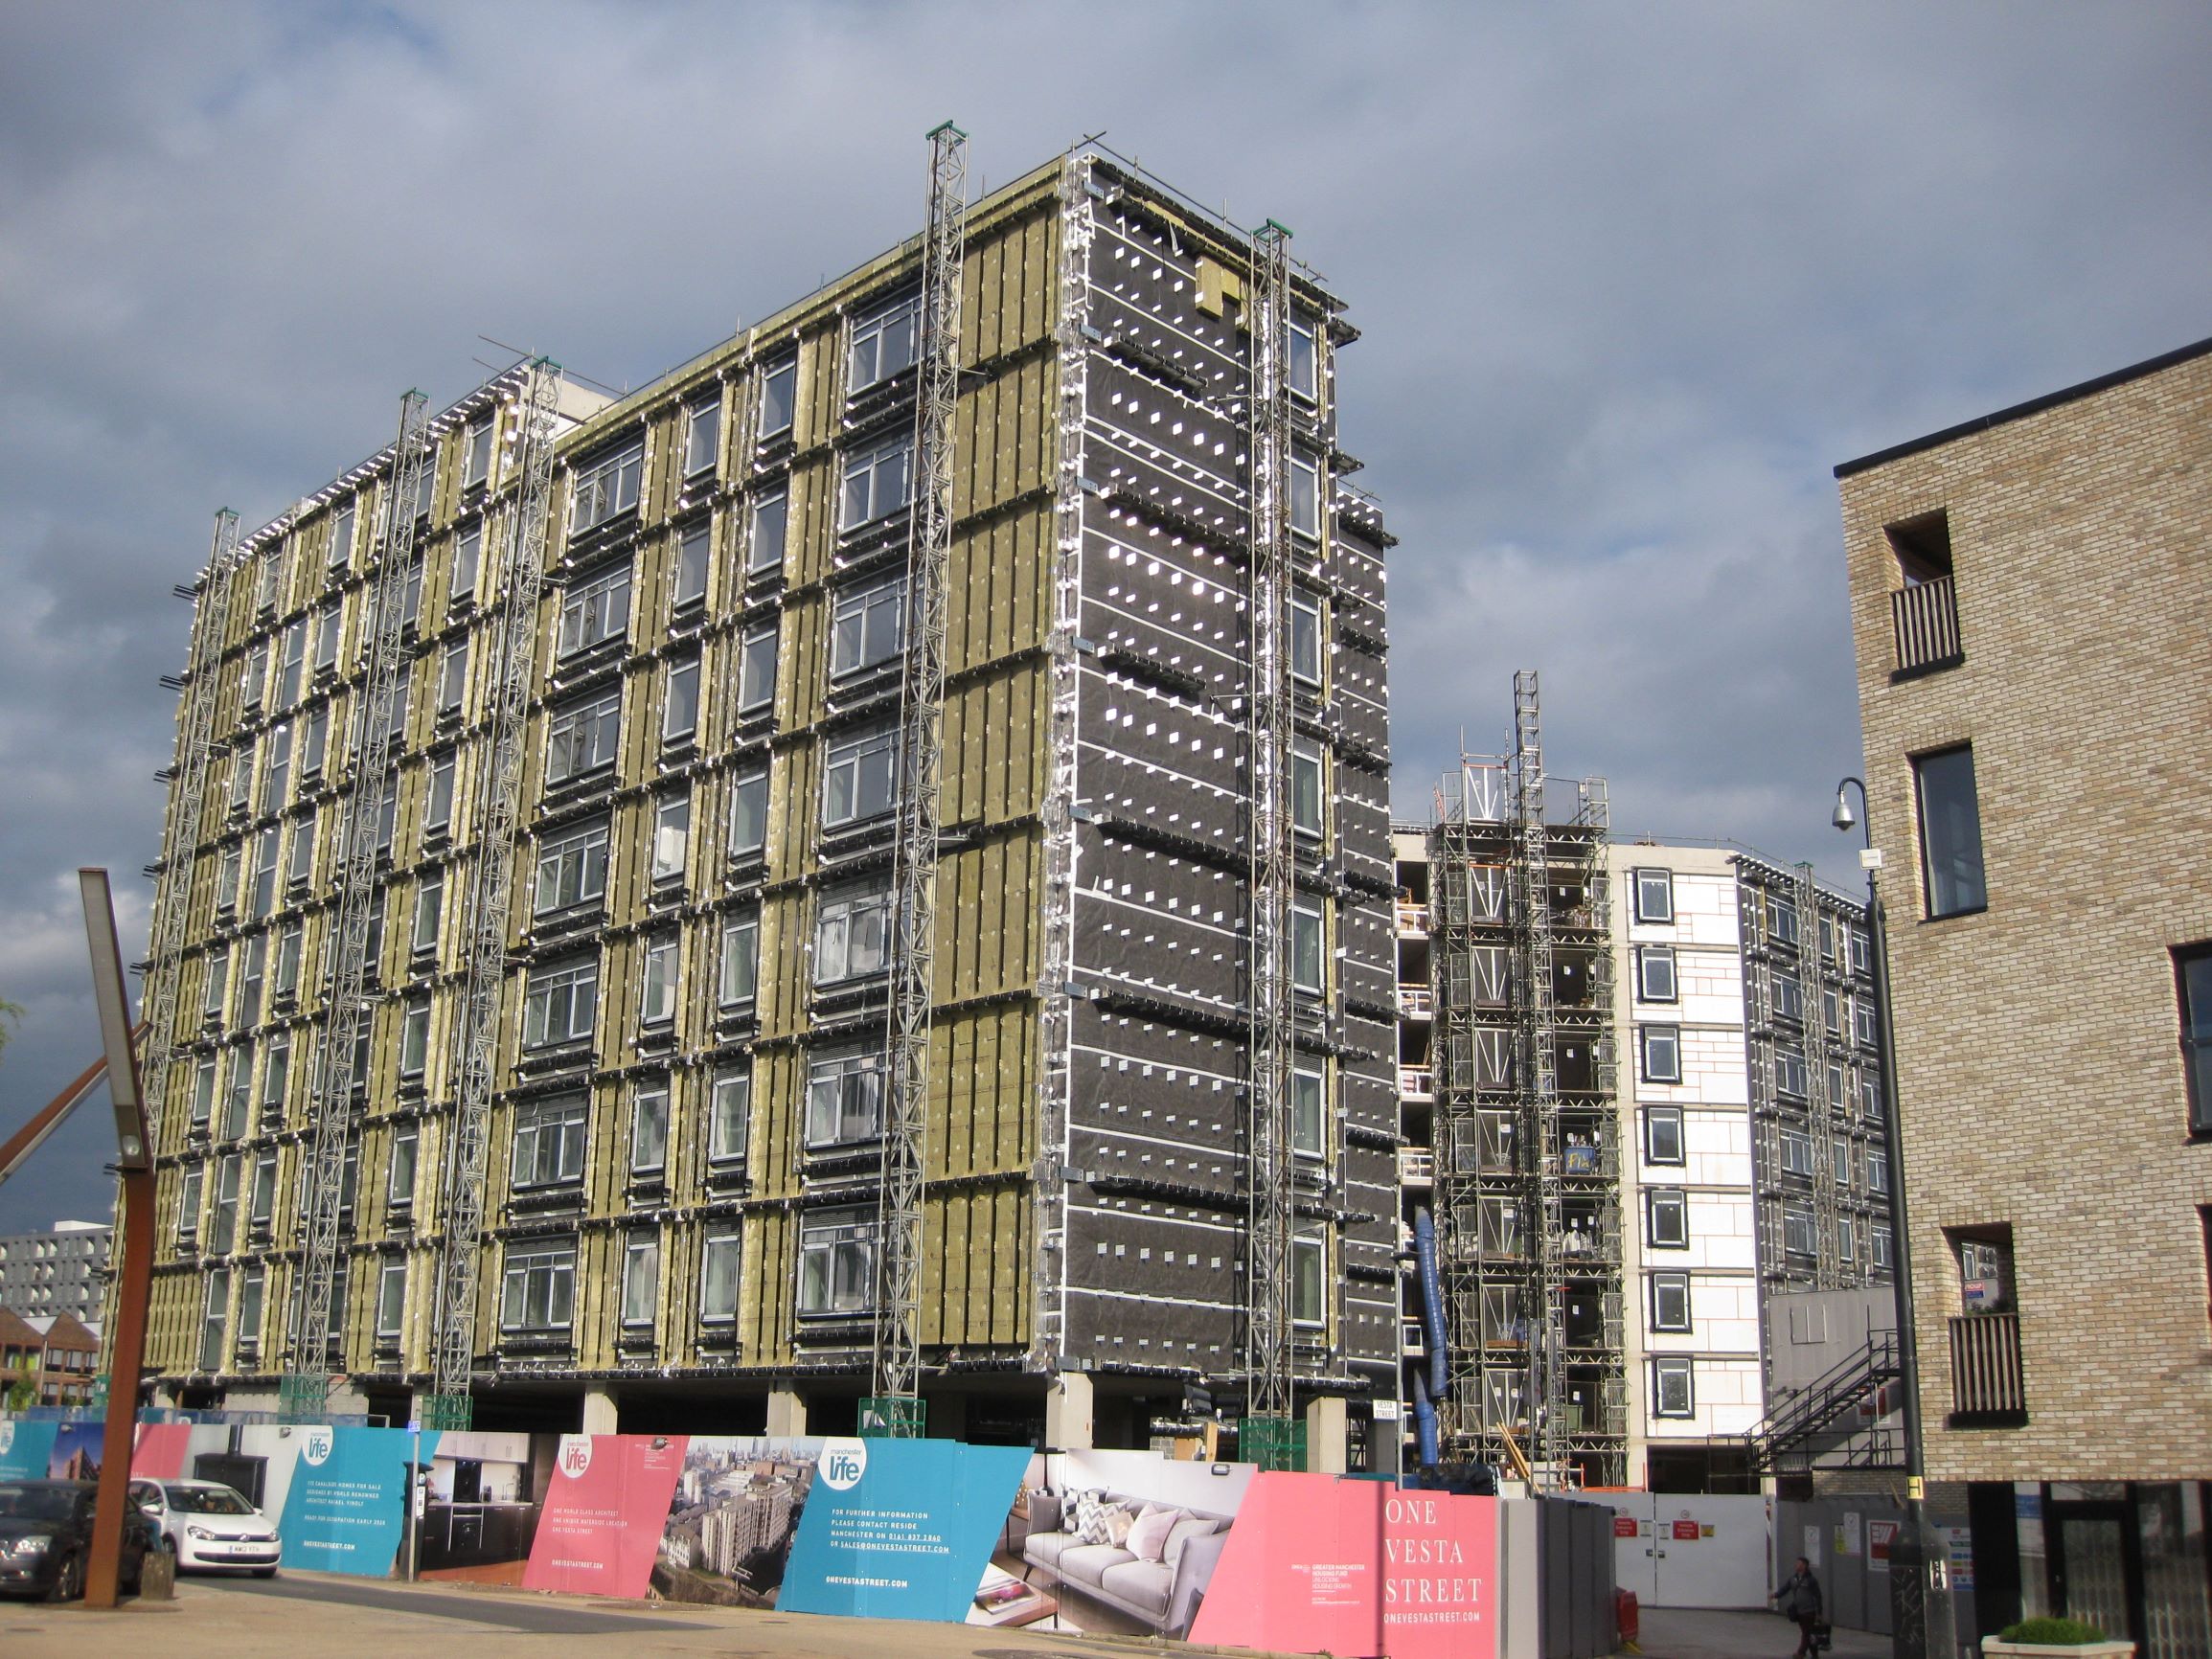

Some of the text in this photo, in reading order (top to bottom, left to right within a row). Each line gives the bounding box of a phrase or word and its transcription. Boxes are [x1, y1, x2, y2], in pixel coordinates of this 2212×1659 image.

[1377, 1400, 1393, 1409] VESTA
[1376, 1409, 1394, 1419] STREET
[308, 1438, 329, 1459] life
[831, 1447, 862, 1456] manchester
[565, 1447, 587, 1470] life
[830, 1455, 859, 1482] life
[419, 1473, 425, 1483] P
[878, 1511, 928, 1519] INFORMATION
[1385, 1498, 1437, 1524] ONE
[856, 1520, 888, 1529] CONTACT
[831, 1530, 873, 1539] MANCHESTER
[839, 1540, 950, 1554] SALES@ONEVESTASTREET.COM
[1385, 1538, 1463, 1563] VESTA
[826, 1575, 908, 1589] ONEVESTASTREET.COM
[1385, 1578, 1482, 1603] STREET
[1383, 1611, 1480, 1625] ONEVESTASTREET.COM
